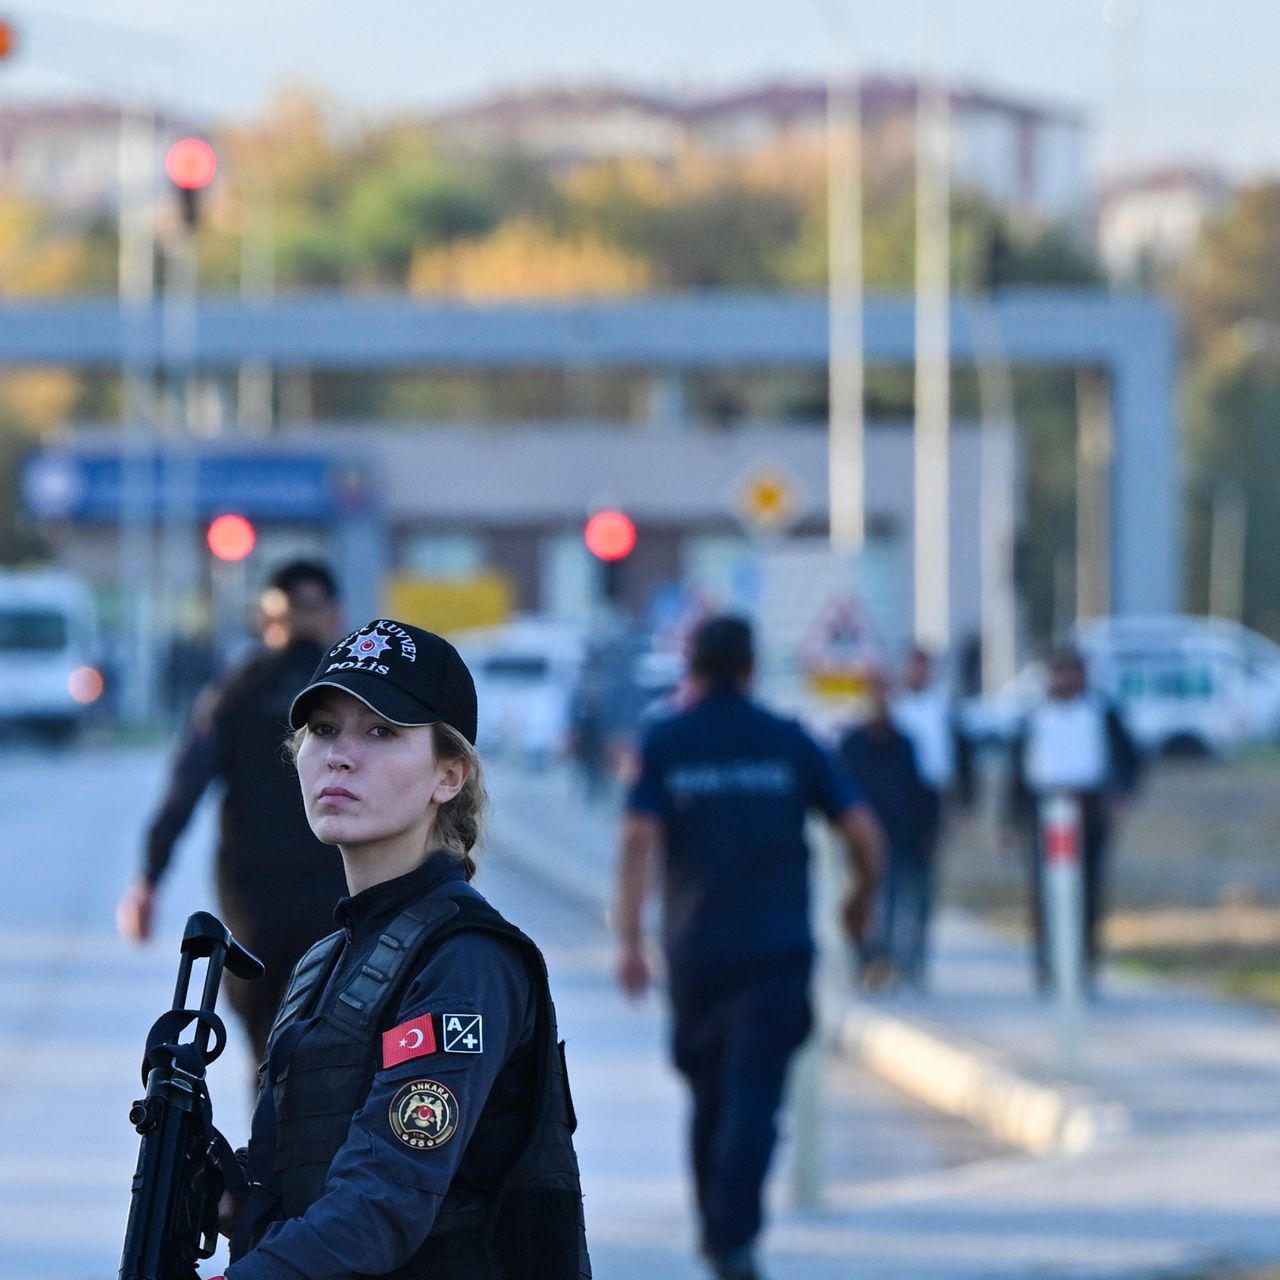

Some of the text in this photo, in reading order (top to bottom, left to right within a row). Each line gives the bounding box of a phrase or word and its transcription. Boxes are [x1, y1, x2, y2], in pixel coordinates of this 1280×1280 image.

[375, 620, 417, 663] KUVVET
[325, 661, 390, 675] POLİS
[410, 1083, 449, 1101] ANKARA
